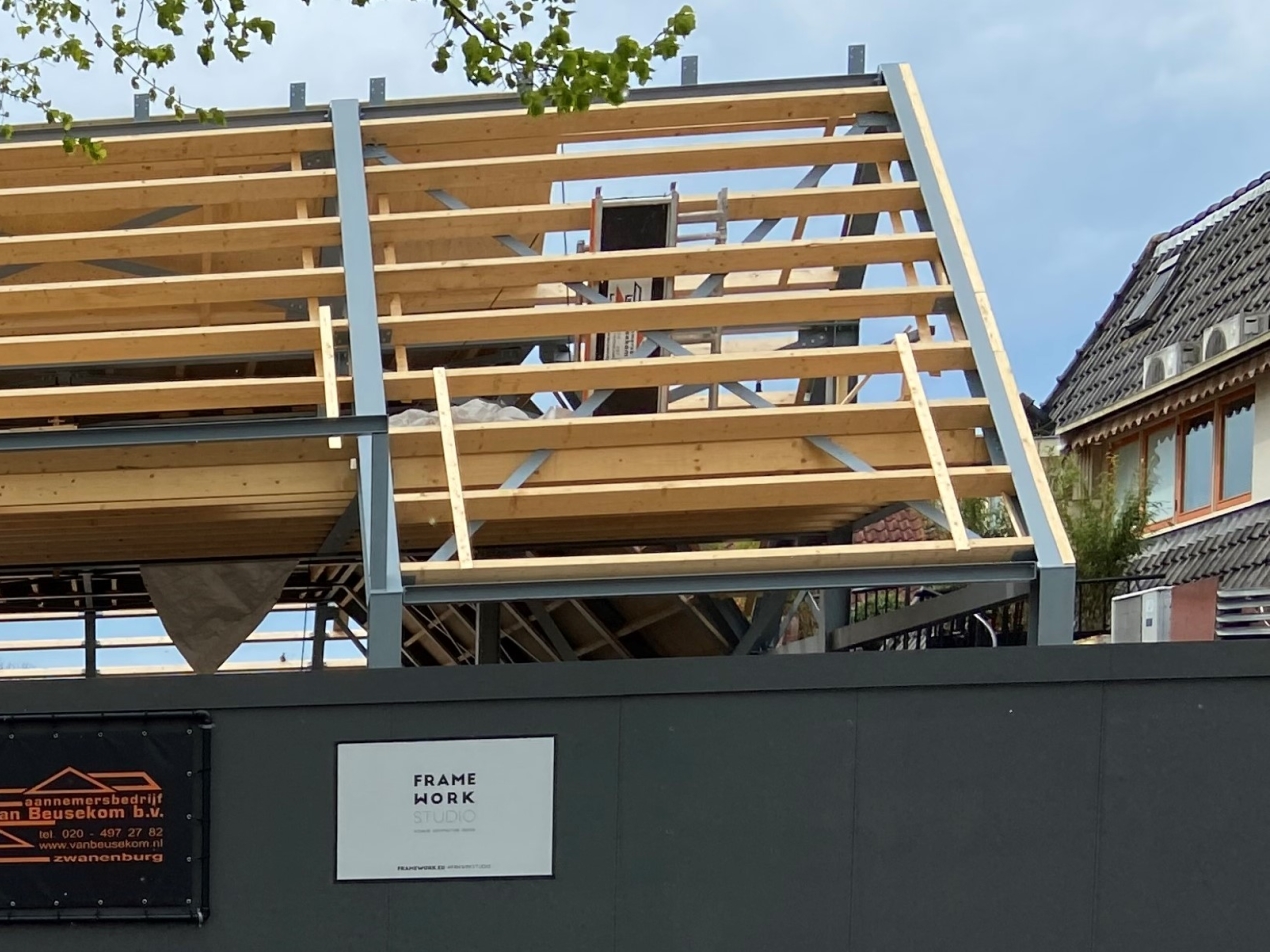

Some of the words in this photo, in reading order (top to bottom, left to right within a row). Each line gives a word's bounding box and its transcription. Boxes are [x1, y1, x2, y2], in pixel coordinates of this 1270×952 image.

[413, 773, 476, 787] FRAME
[25, 793, 163, 807] aannemersbedrijf
[413, 791, 475, 805] WORK
[28, 806, 125, 820] Beusekom
[133, 805, 164, 818] b.v.
[413, 809, 476, 823] STUDIO
[62, 829, 84, 838] 020
[100, 828, 121, 838] 497
[128, 828, 143, 837] 27
[149, 827, 163, 837] 82
[39, 839, 163, 850] www.vanbeusekom.nl
[53, 852, 163, 863] zwanenburg
